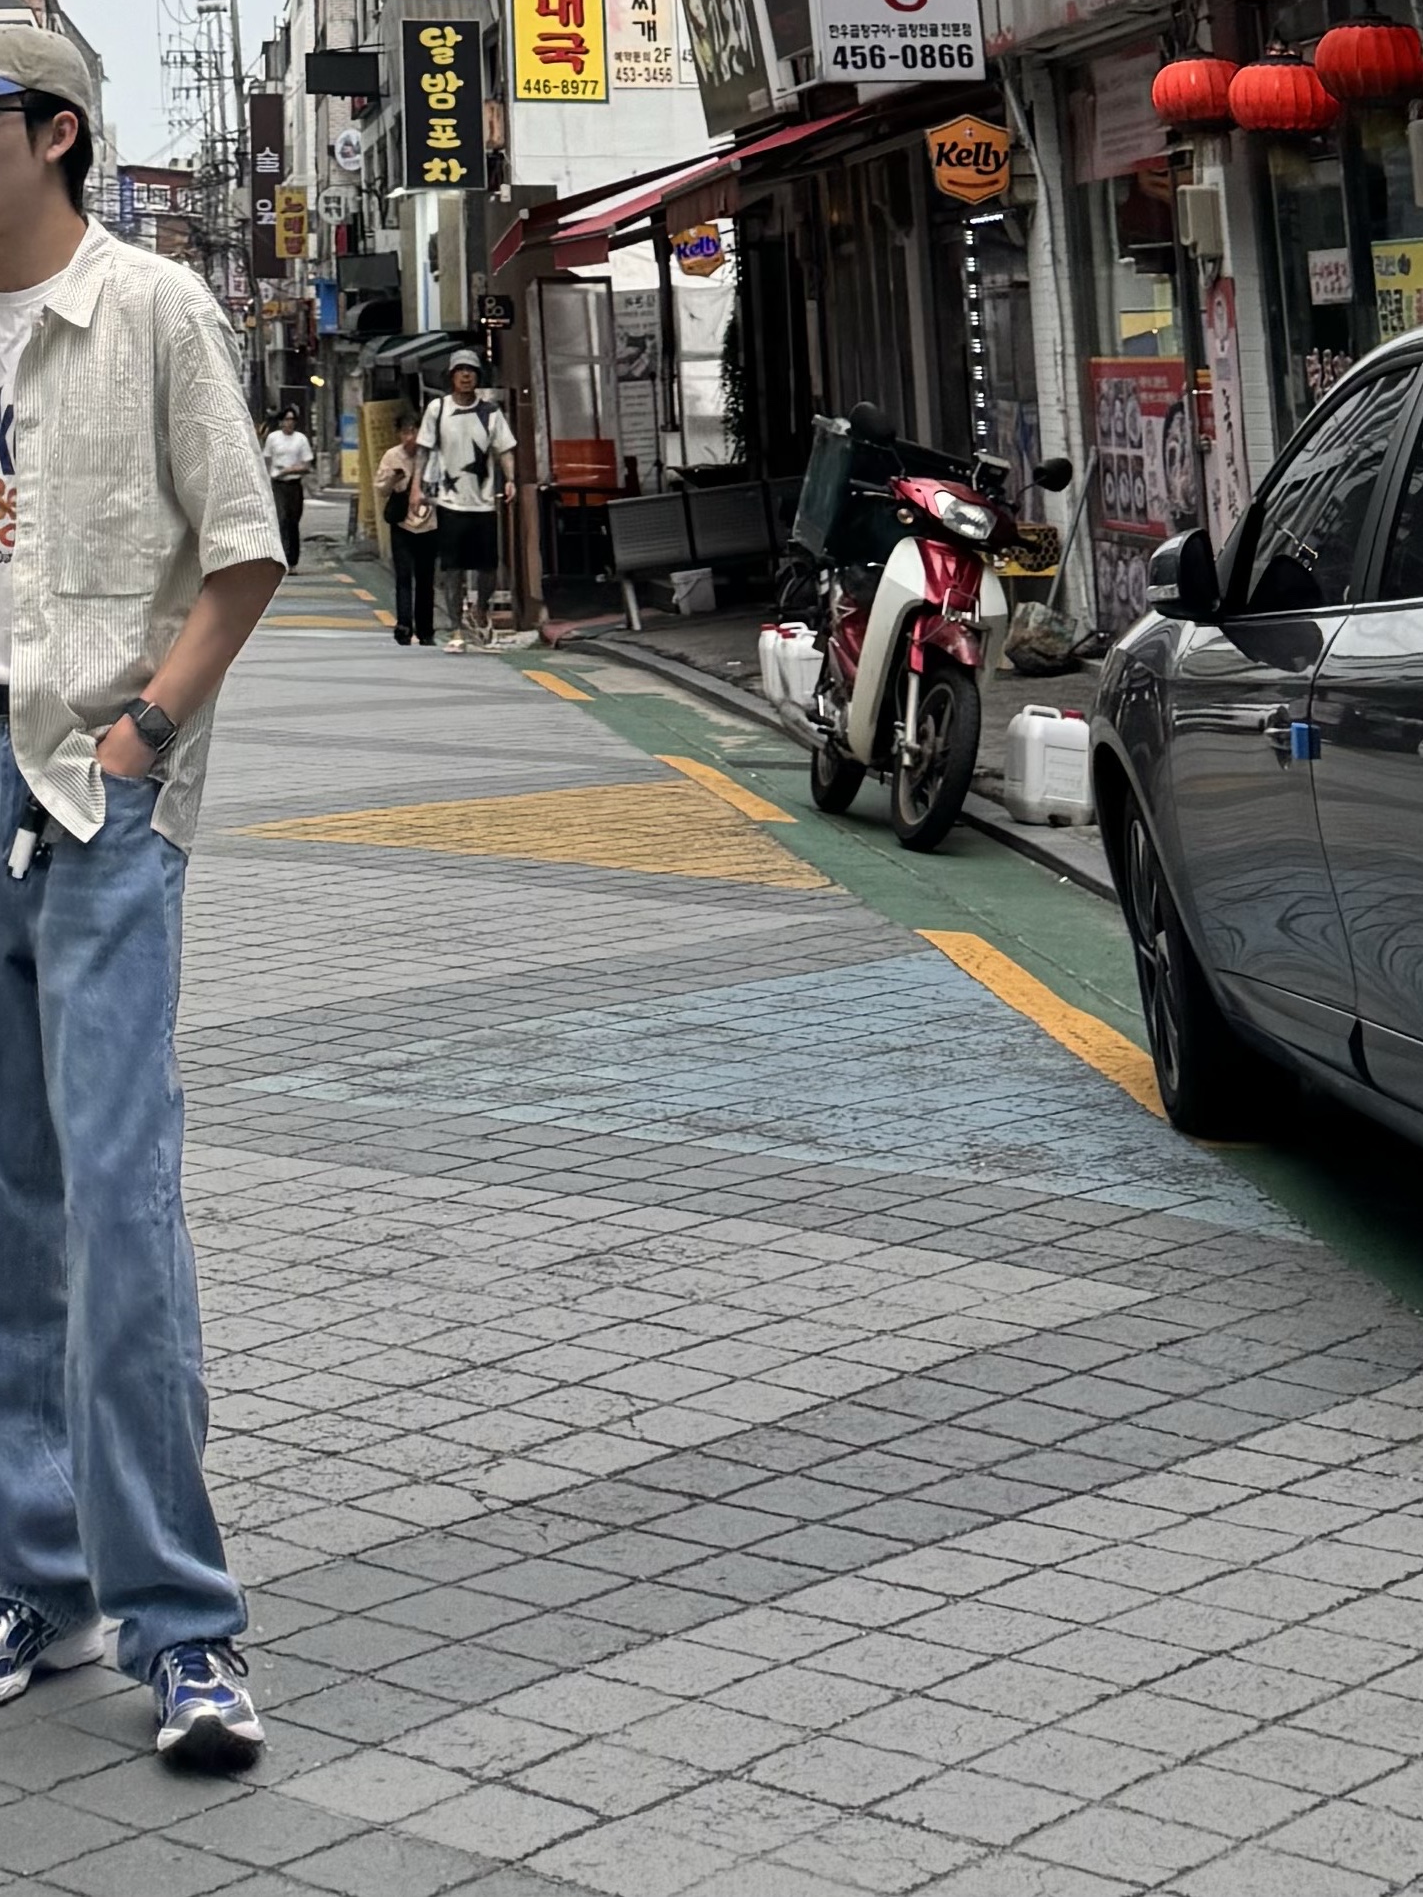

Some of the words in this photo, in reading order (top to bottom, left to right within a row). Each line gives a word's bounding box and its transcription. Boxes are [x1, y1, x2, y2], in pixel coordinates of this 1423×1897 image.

[654, 47, 672, 63] 2F
[833, 44, 973, 69] 456-0866
[522, 79, 598, 96] 446-8977
[418, 25, 468, 183] 달밤포차
[935, 141, 1008, 174] Kelly
[676, 237, 719, 259] Kelly
